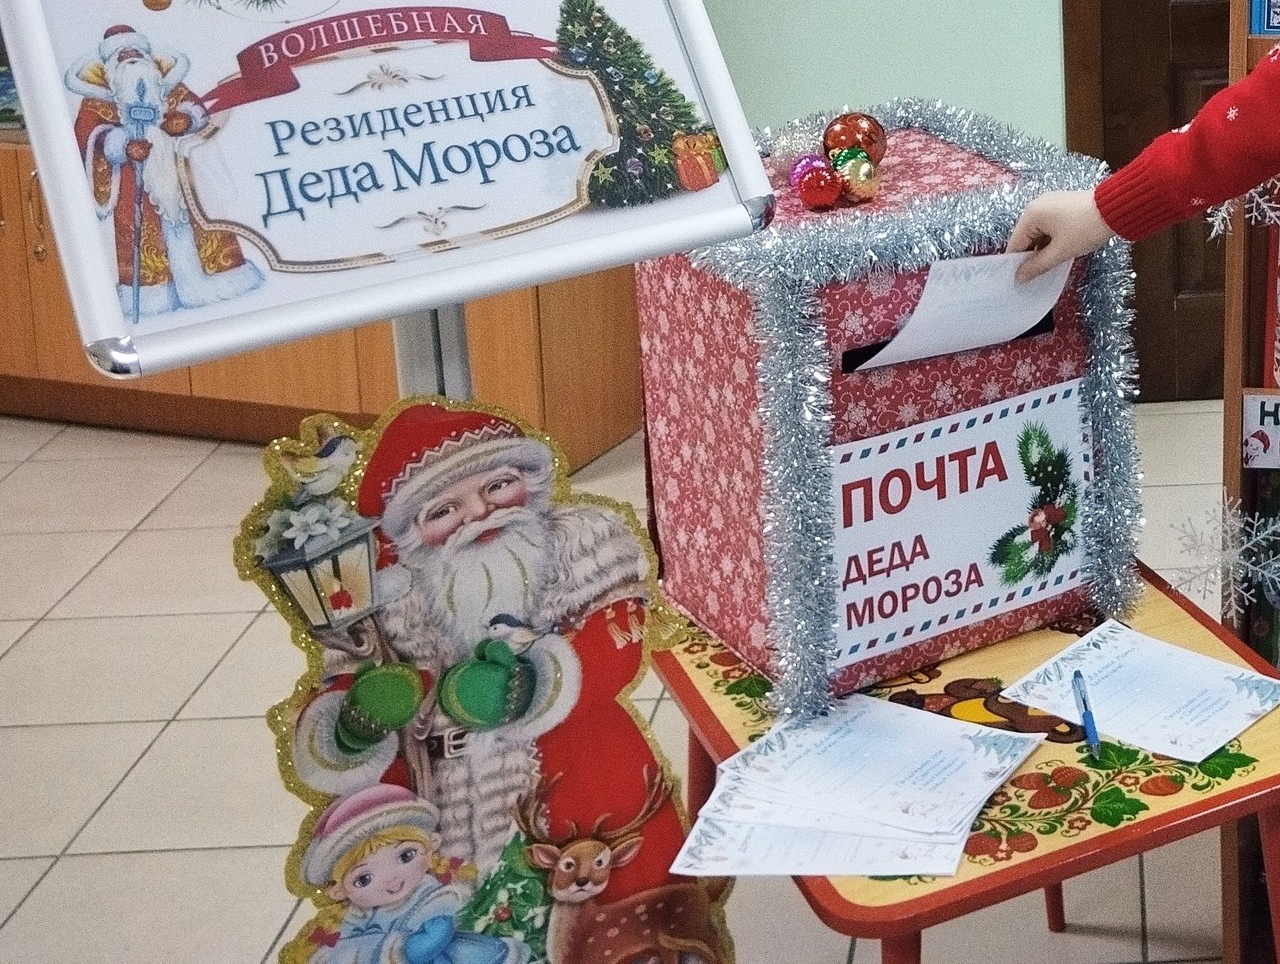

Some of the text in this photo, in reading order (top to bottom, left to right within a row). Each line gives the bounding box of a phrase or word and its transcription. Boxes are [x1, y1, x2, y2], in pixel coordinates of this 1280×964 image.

[259, 11, 489, 70] ВОЛШЕБНАЯ
[266, 84, 536, 157] Резиденция
[254, 123, 582, 229] Деда Мороза
[842, 440, 1008, 528] ПОЧТА
[842, 534, 930, 592] ДЕДА
[846, 562, 985, 631] МОРОЗА
